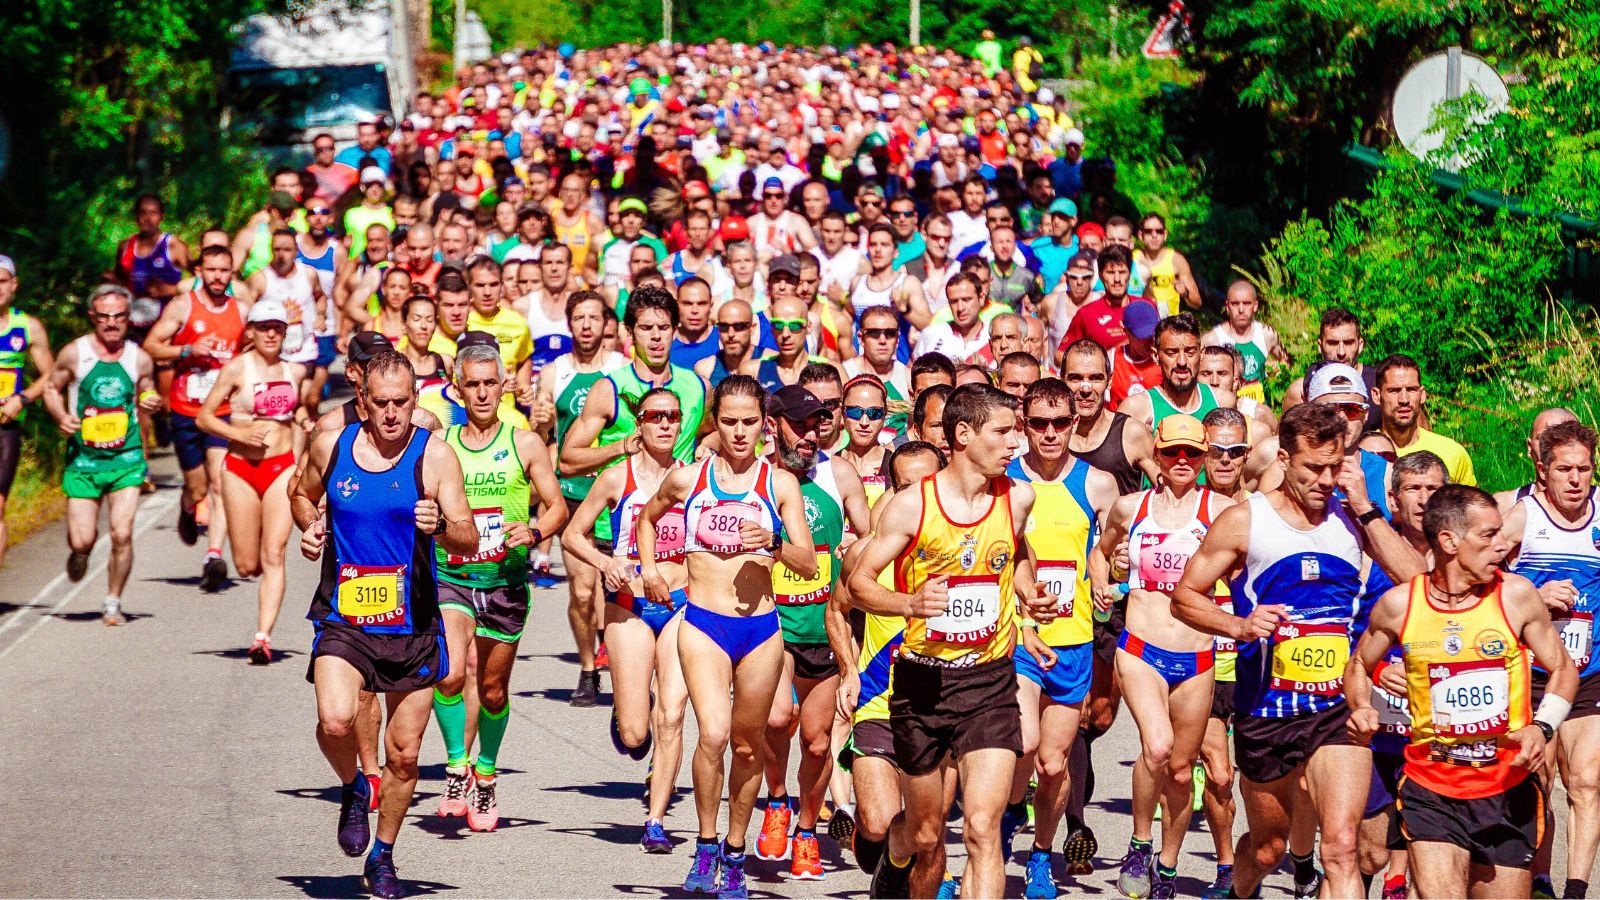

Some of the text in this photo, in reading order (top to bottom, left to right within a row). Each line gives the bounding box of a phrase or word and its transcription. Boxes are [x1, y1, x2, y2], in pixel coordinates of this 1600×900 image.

[263, 396, 289, 409] 4685
[465, 487, 507, 497] ETISMO
[711, 544, 744, 554] DOU
[341, 566, 358, 580] edp
[355, 586, 388, 603] 3119
[788, 584, 831, 603] DOURO
[356, 607, 404, 624] DOURO
[945, 623, 997, 643] DOURO
[1278, 624, 1300, 640] edp
[1291, 647, 1336, 668] 4620
[1445, 685, 1494, 708] 4686
[1454, 710, 1509, 735] DOURO
